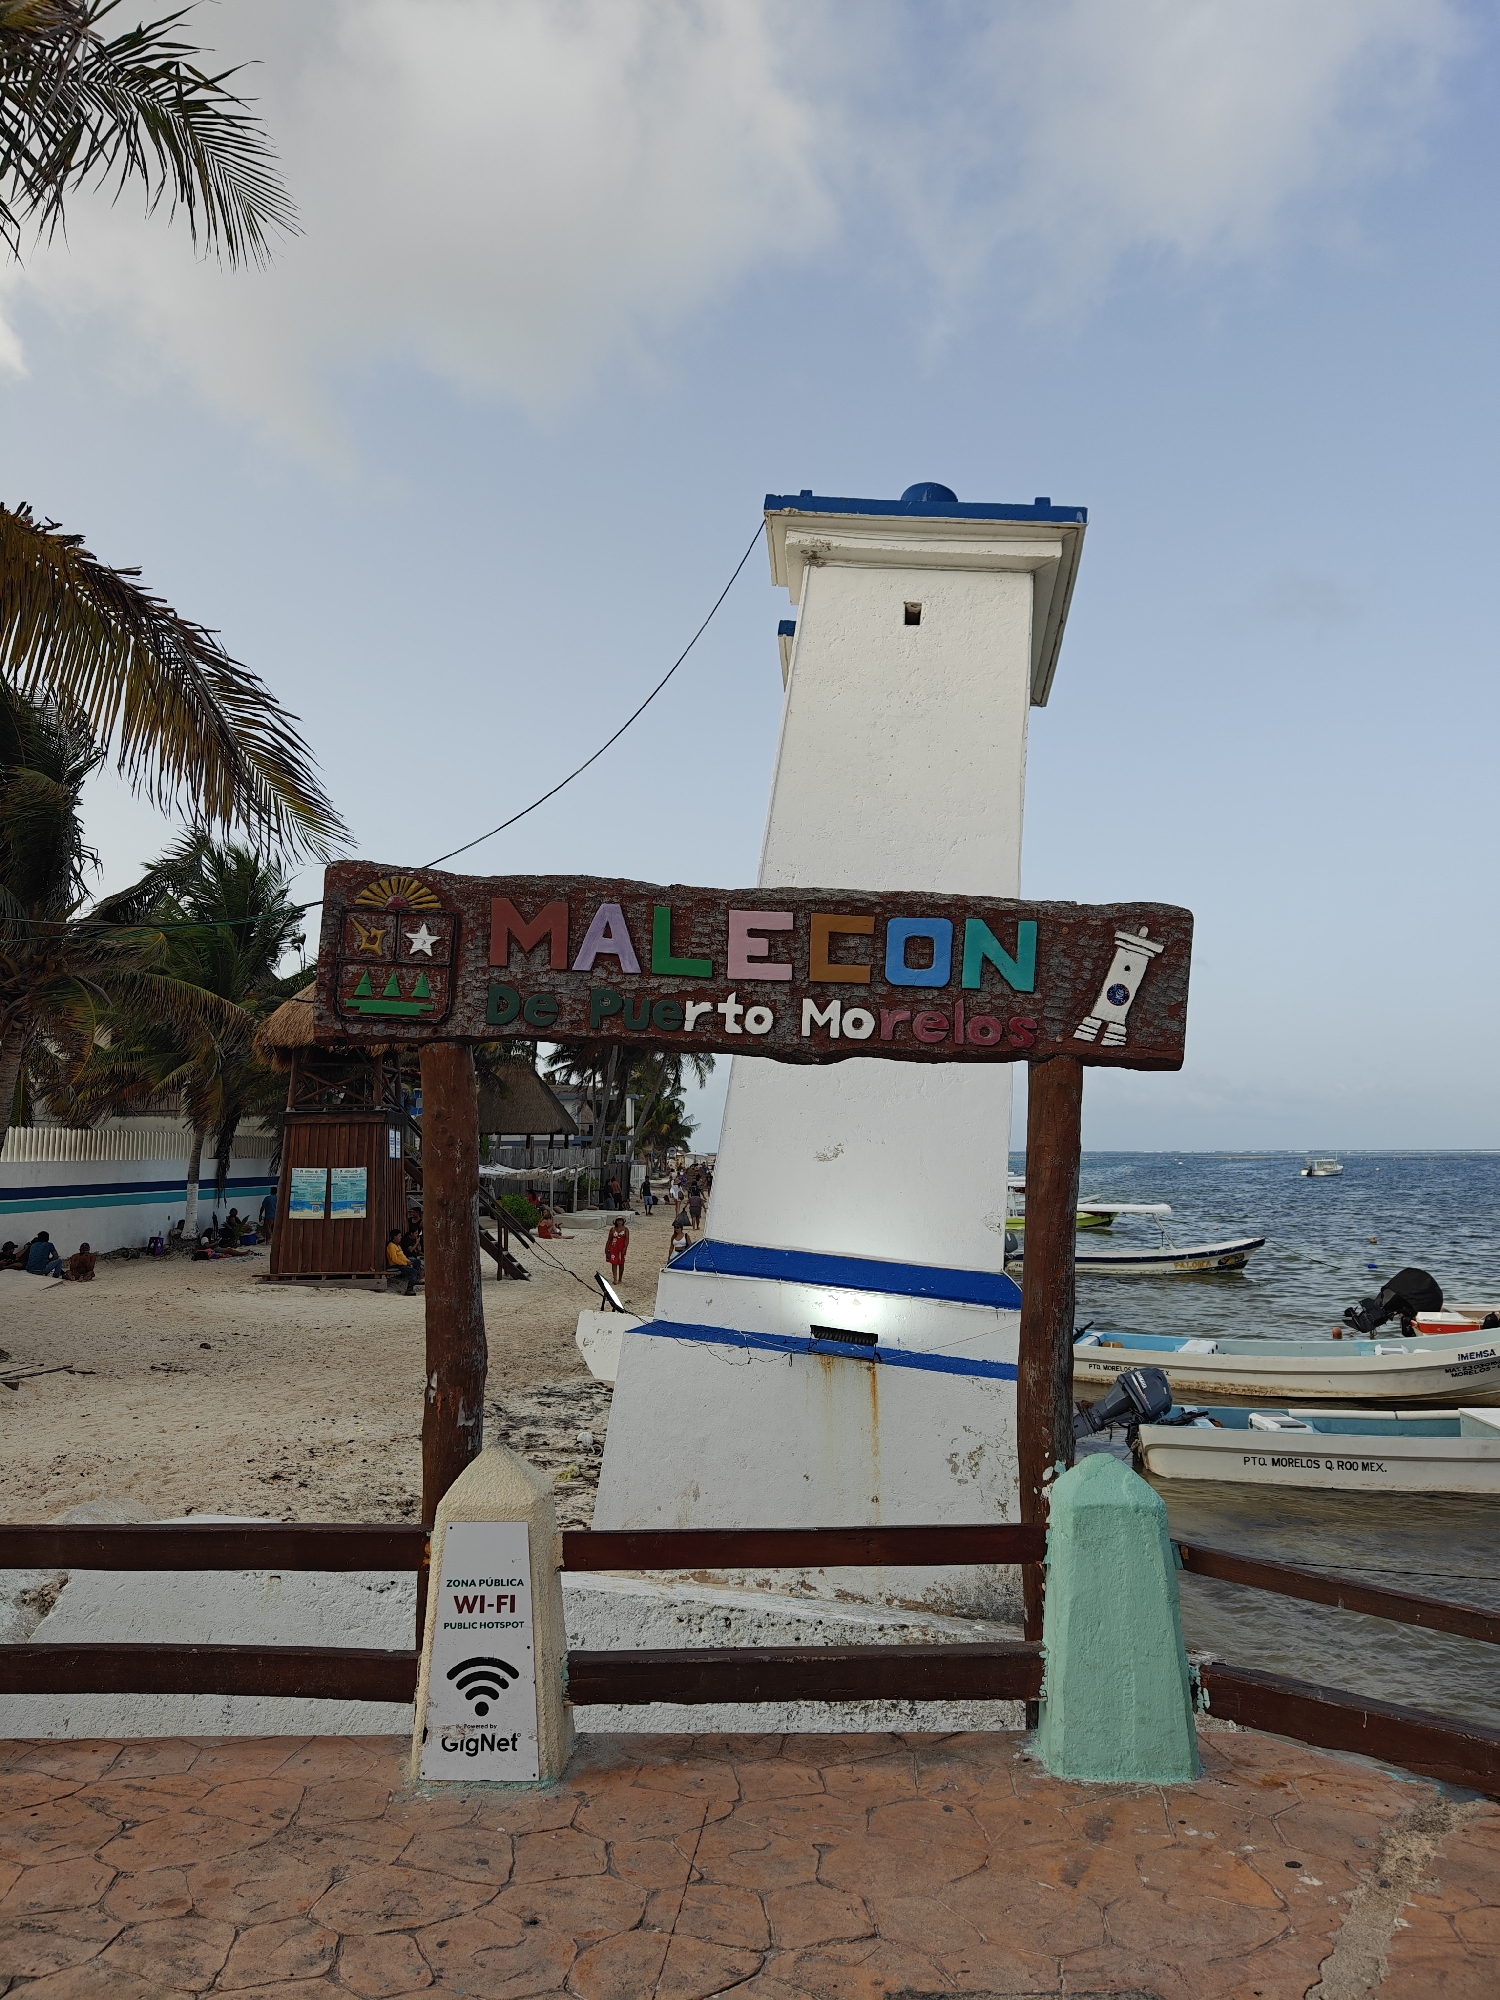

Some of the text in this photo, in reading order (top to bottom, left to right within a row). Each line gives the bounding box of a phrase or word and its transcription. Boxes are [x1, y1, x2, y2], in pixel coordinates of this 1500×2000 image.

[489, 898, 1038, 993] MALECON
[487, 984, 1038, 1049] De Puerto Morelos
[1457, 1349, 1496, 1361] IMEMSA
[1271, 1457, 1320, 1469] MORELOS
[1337, 1460, 1359, 1472] ROO
[1361, 1461, 1388, 1473] MEX.
[446, 1576, 524, 1588] ZONA PÚBLICA
[453, 1594, 516, 1615] WI-FI
[443, 1621, 525, 1630] PUBLIC HOTSPOT
[441, 1732, 519, 1758] GigNet
